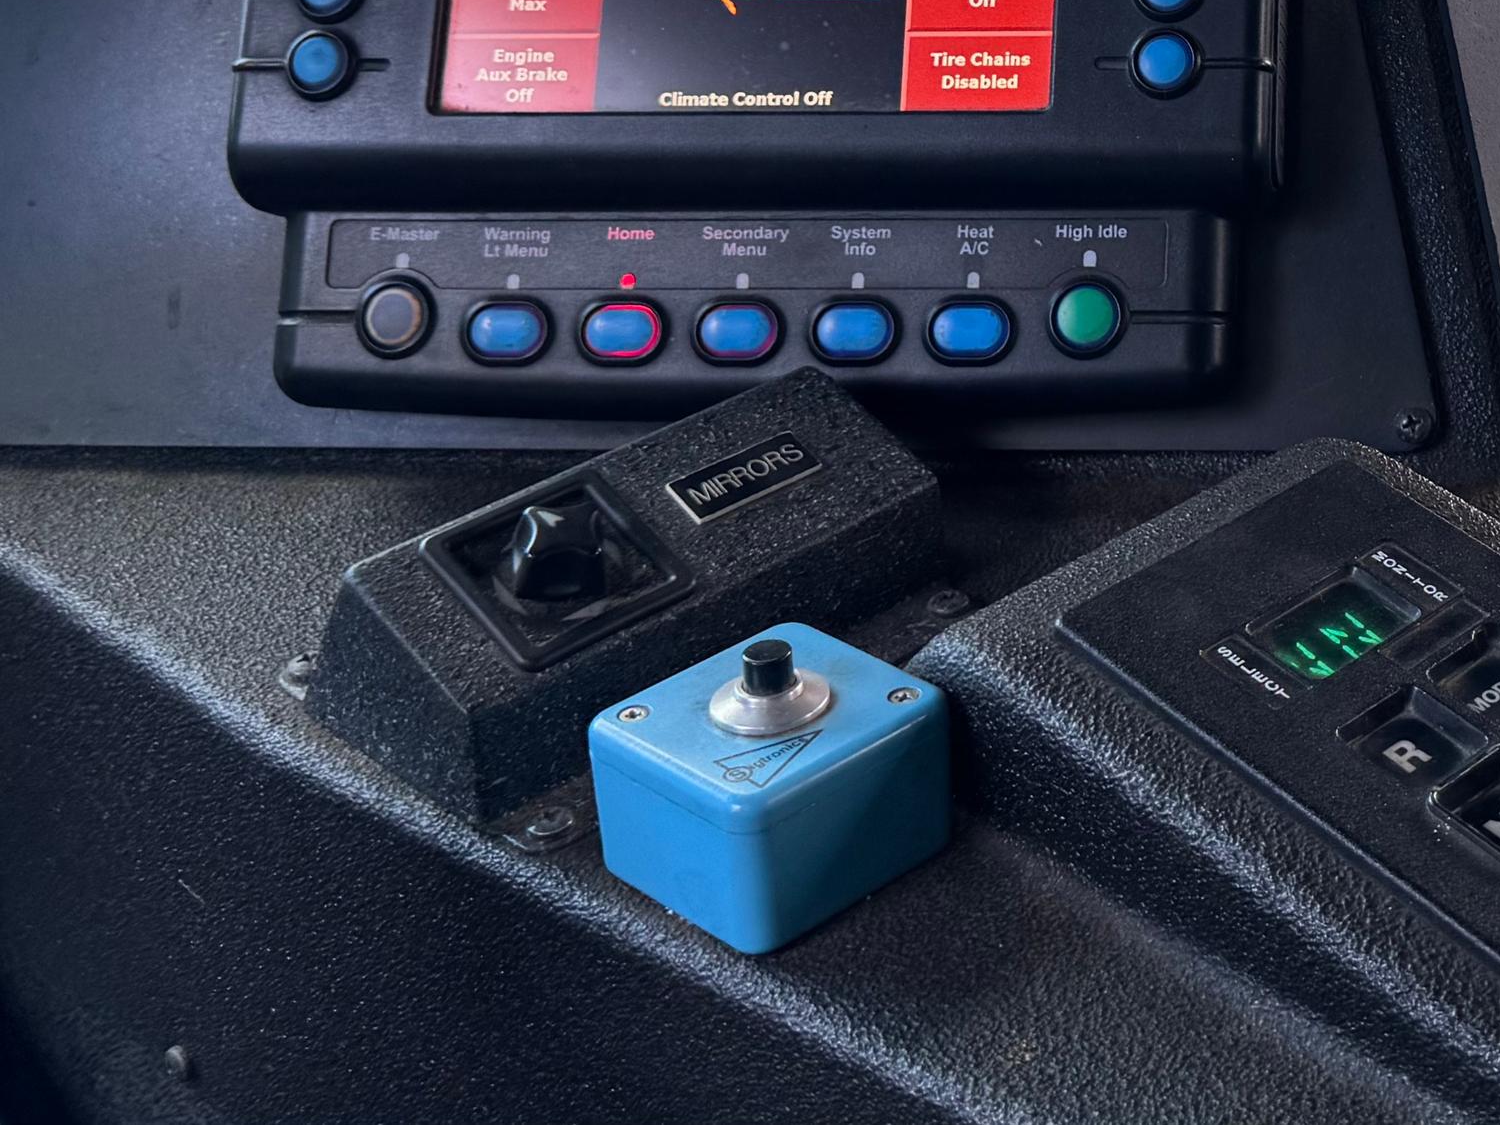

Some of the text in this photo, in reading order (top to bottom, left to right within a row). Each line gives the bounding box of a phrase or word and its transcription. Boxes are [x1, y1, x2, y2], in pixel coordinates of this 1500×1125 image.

[493, 48, 555, 65] Engine
[930, 52, 1031, 66] Tire Chains
[475, 67, 568, 81] Aux Brake
[941, 74, 1019, 89] Disabled
[506, 88, 535, 103] Off
[659, 91, 834, 106] Climate Control Off
[370, 227, 440, 241] E-Master
[484, 227, 550, 243] Warning
[607, 227, 656, 241] Home
[702, 226, 789, 243] Secondary
[831, 226, 892, 242] System
[957, 225, 994, 239] Heat
[1055, 225, 1128, 241] High Idle
[484, 244, 548, 257] Lt Menu
[722, 243, 767, 256] Menu
[844, 242, 876, 256] Info
[960, 241, 989, 255] A/C
[686, 444, 804, 505] MIRRORS
[1371, 550, 1448, 602] MONITOR
[1217, 645, 1291, 700] SELECT
[1382, 739, 1432, 774] R
